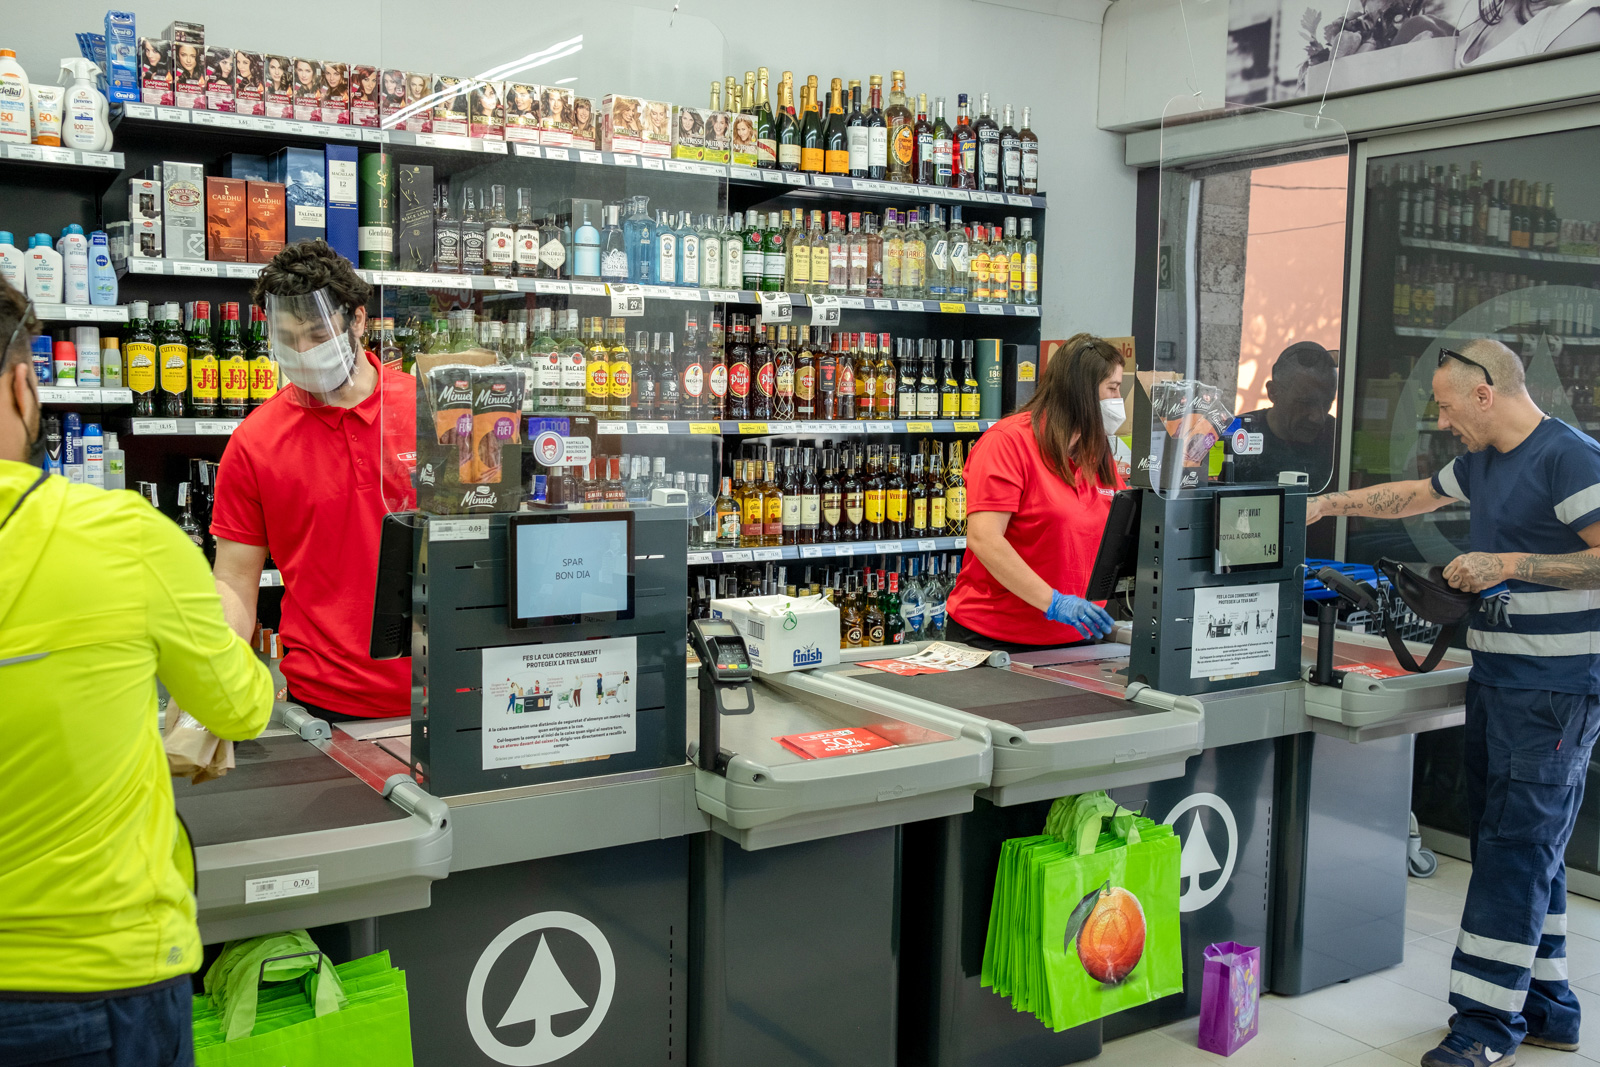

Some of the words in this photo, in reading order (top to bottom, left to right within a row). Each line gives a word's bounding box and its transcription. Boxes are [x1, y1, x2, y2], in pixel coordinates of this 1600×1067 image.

[474, 388, 516, 407] Minuets
[460, 490, 498, 506] Minuets
[562, 558, 583, 567] SPAR
[555, 571, 573, 580] BON
[576, 570, 591, 578] DIA
[555, 650, 598, 659] CORRECTAMENT
[793, 648, 822, 663] finish
[526, 660, 558, 669] PROTEGEIX
[293, 879, 309, 888] 0,70
